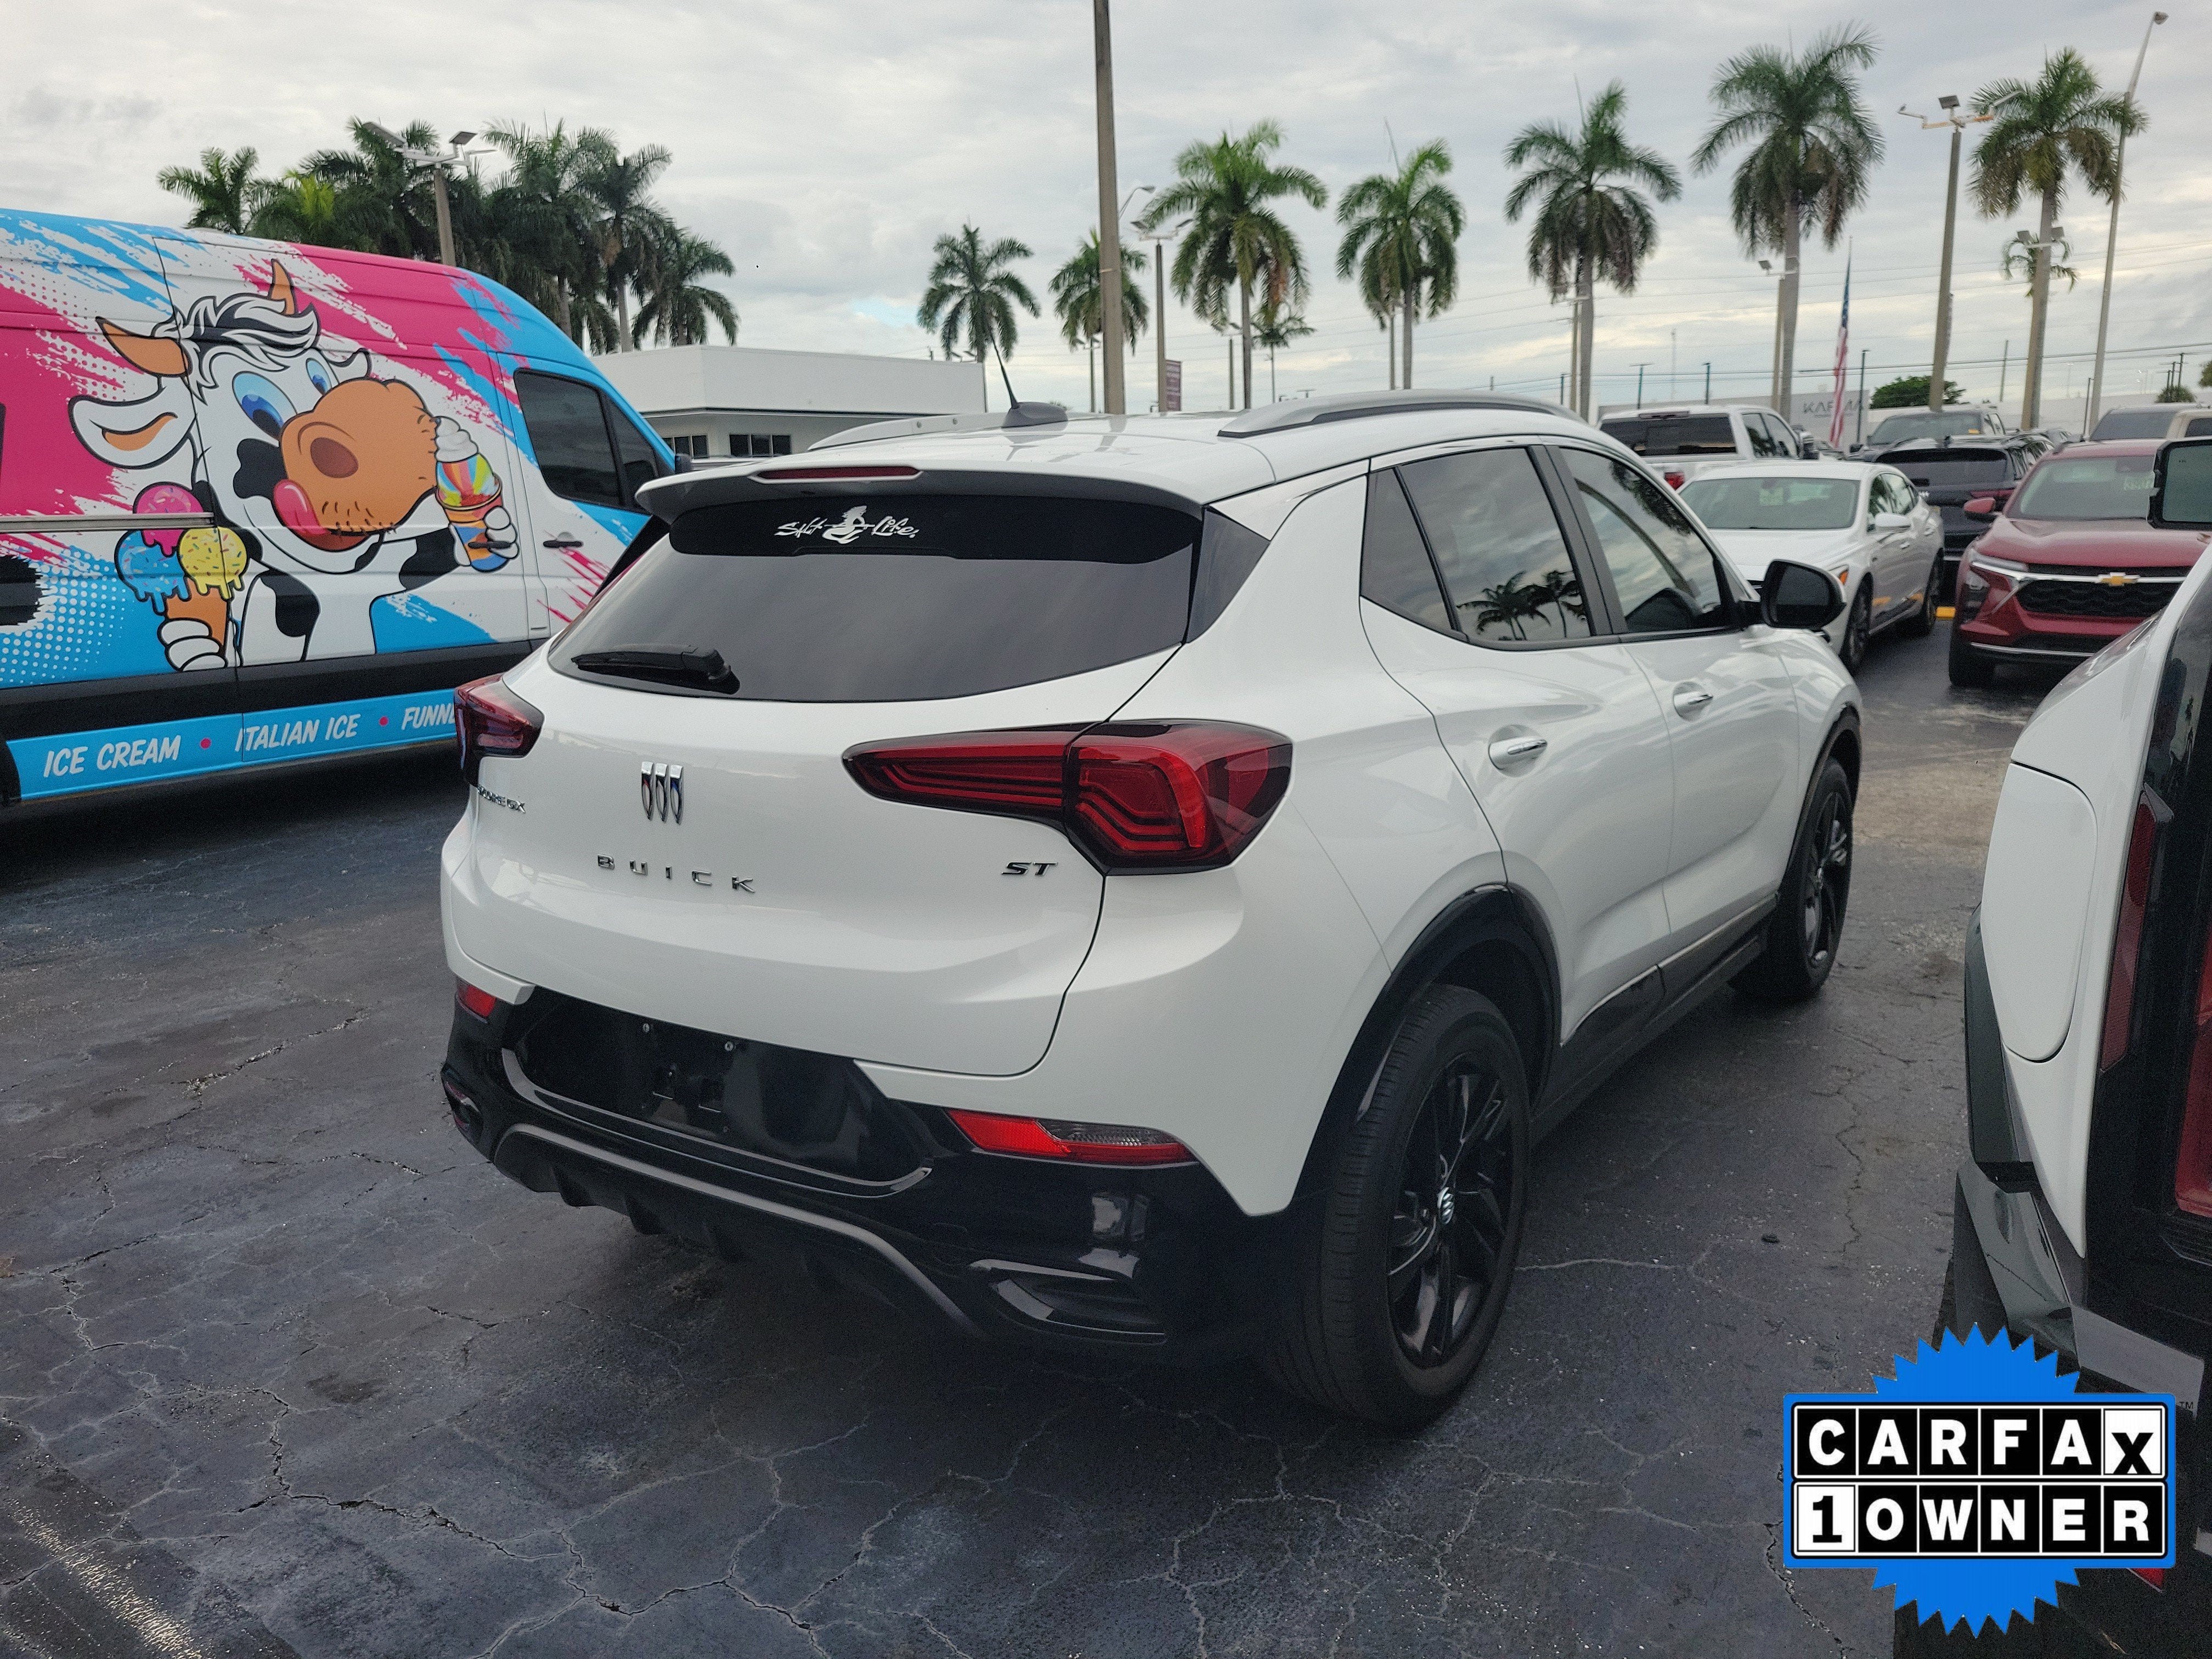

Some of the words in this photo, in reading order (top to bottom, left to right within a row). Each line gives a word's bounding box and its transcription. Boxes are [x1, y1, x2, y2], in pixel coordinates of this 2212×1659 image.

[43, 746, 88, 777] ICE
[97, 735, 182, 770] CREAM
[234, 719, 320, 752] ITALIAN
[325, 714, 362, 740] ICE
[597, 854, 755, 893] BUICK
[1001, 861, 1059, 876] ST
